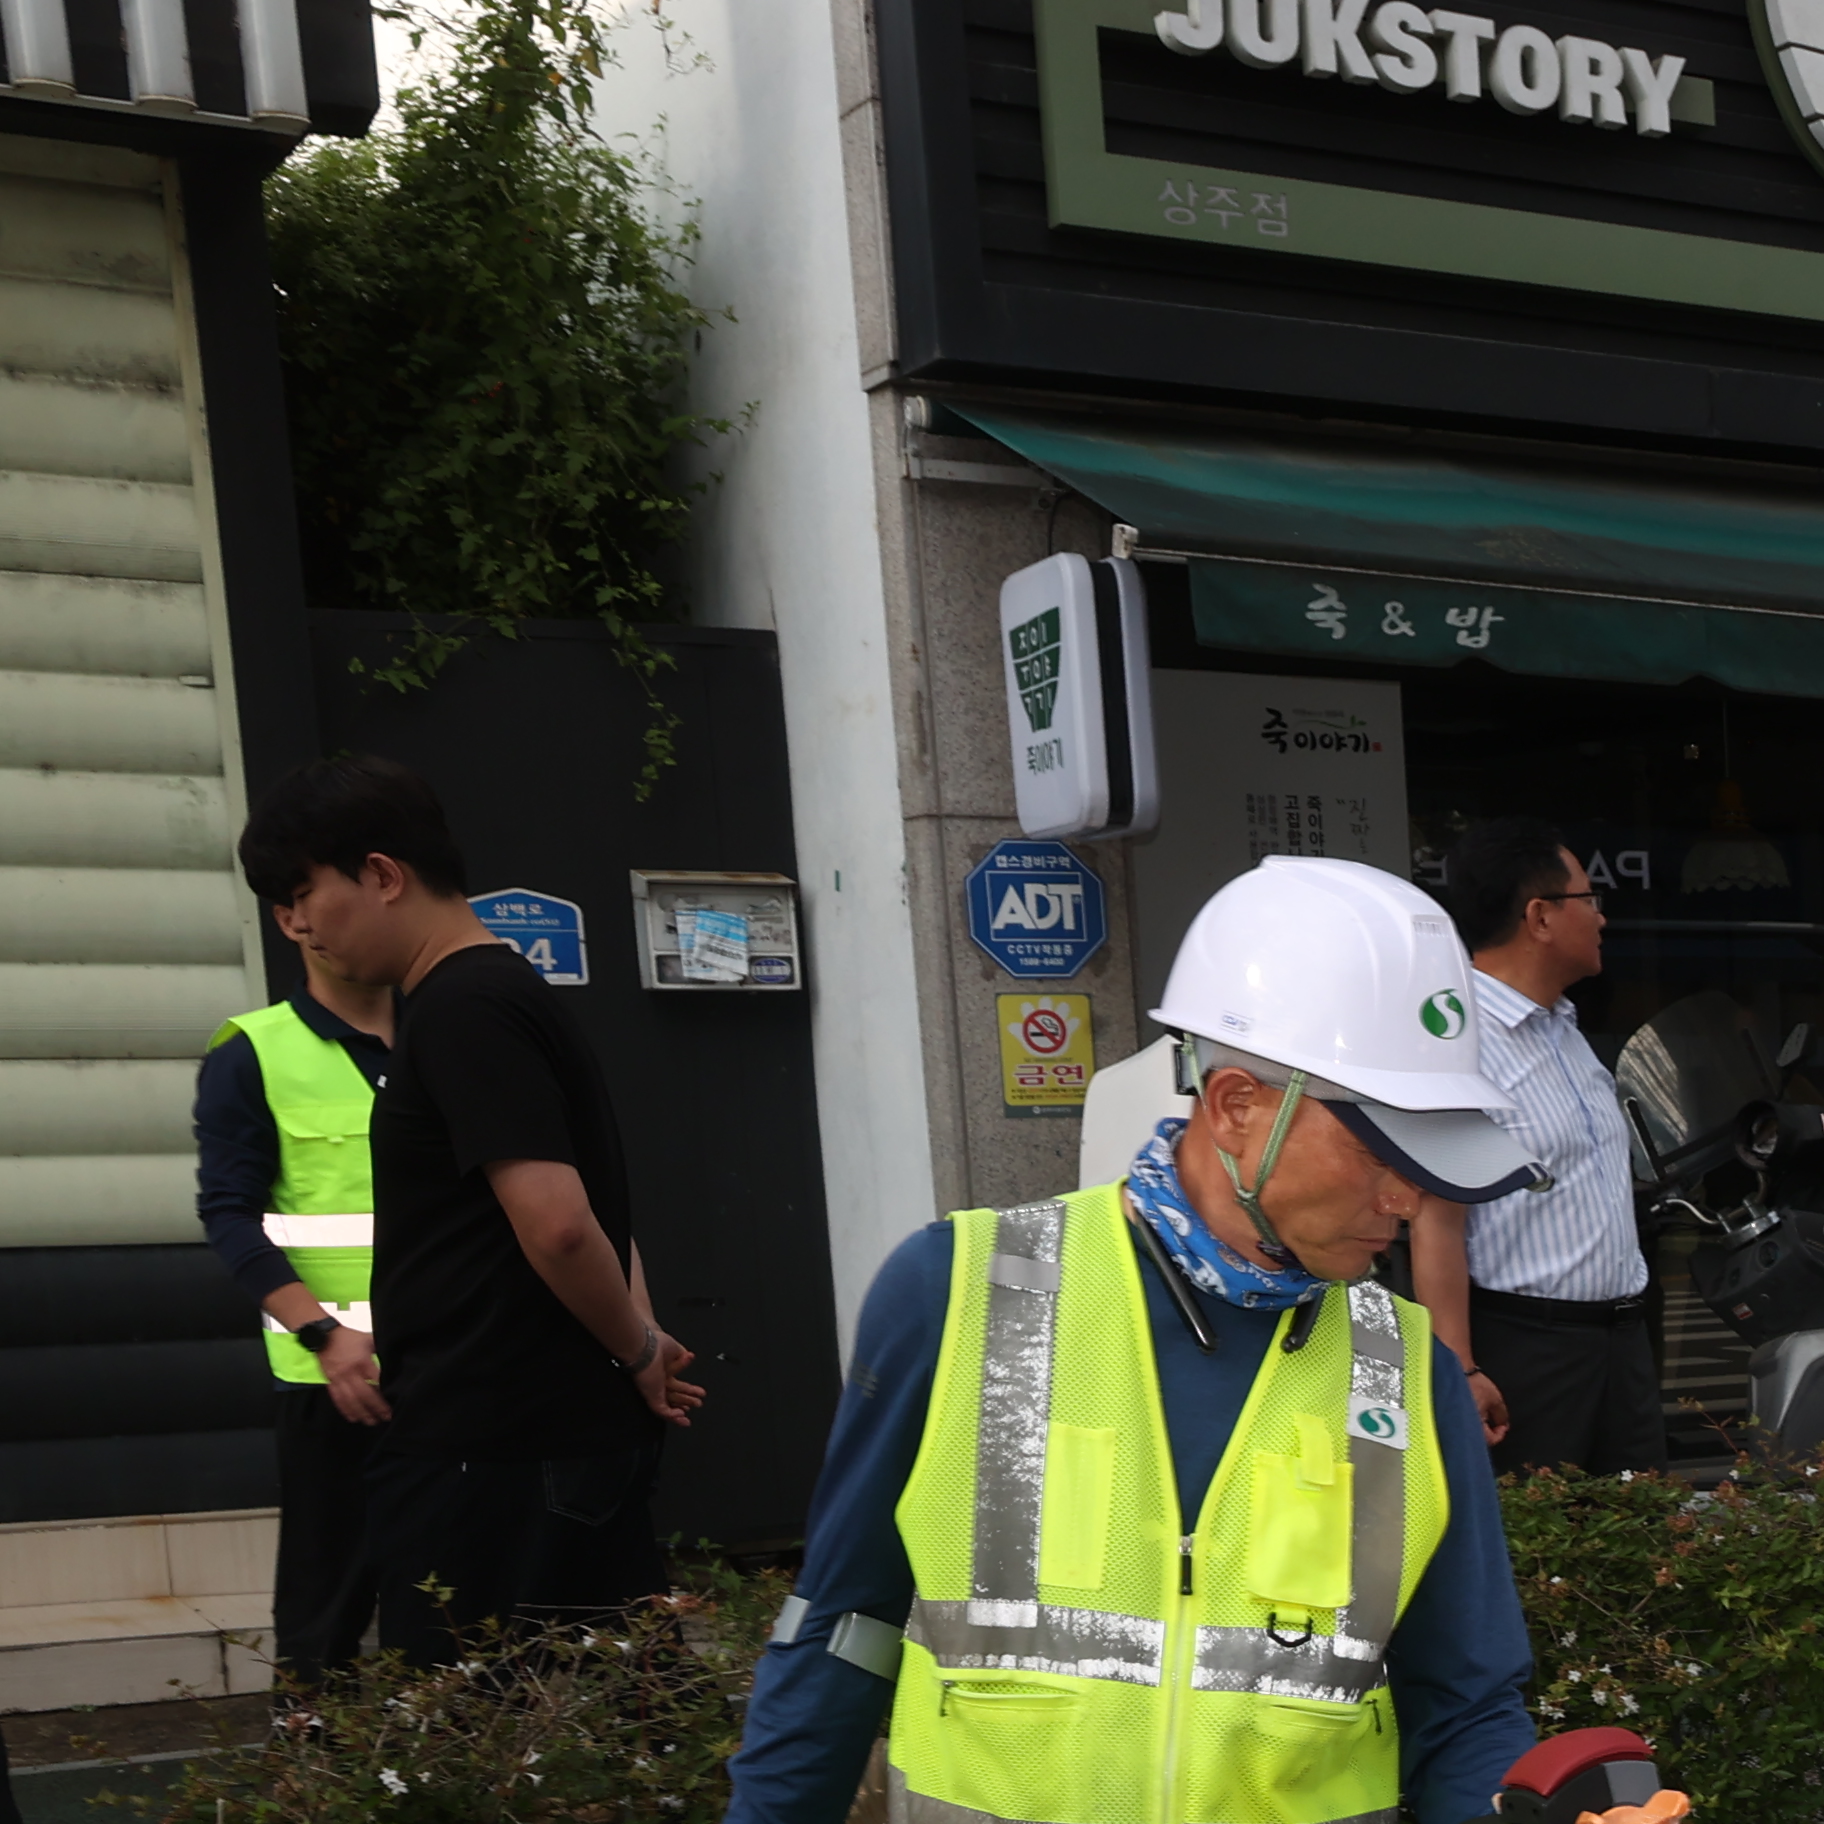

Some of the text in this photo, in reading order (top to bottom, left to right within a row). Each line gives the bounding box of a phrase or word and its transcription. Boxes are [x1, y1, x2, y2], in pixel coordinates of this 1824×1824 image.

[1157, 178, 1289, 238] 상주점
[1304, 582, 1505, 648] 죽 & 밥
[1261, 707, 1371, 754] 죽이야기
[995, 854, 1072, 869] 캡스경비구역
[492, 902, 545, 917] 삼백로
[991, 882, 1082, 930] ADT
[1013, 1062, 1085, 1087] 금연
